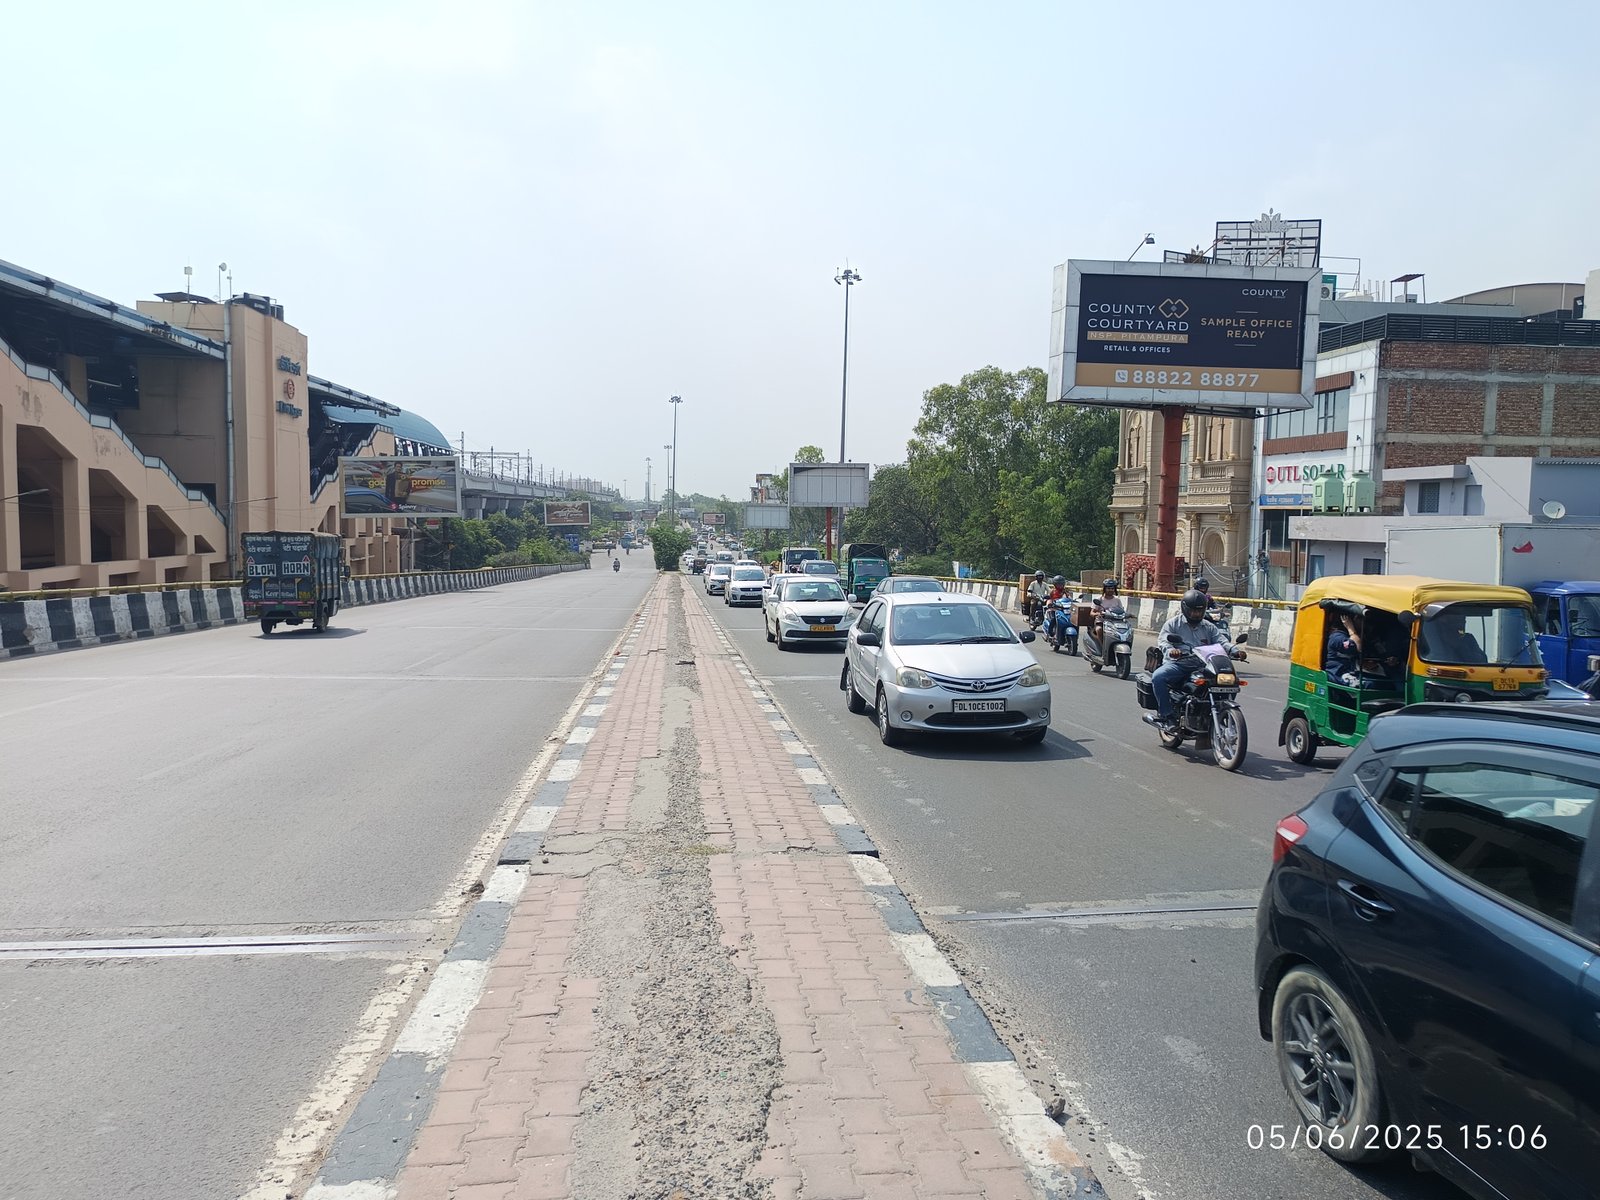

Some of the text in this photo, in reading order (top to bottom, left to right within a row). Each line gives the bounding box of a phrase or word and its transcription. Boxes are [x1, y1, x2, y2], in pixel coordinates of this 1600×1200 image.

[1242, 288, 1287, 297] COUNTY
[1088, 303, 1156, 315] COUNTY
[1087, 318, 1189, 332] COURTYARD
[1200, 317, 1293, 328] SAMPLE OFFICE
[1121, 333, 1186, 342] PITAMPURA
[1226, 330, 1265, 339] READY
[1103, 345, 1130, 353] RETAIL
[1139, 346, 1171, 354] OFFICES
[1132, 370, 1260, 387] 88822 88877
[1277, 465, 1302, 482] UTL
[411, 479, 446, 488] promise
[248, 562, 310, 576] BLOW HORN
[958, 702, 1004, 711] DL10CE1002
